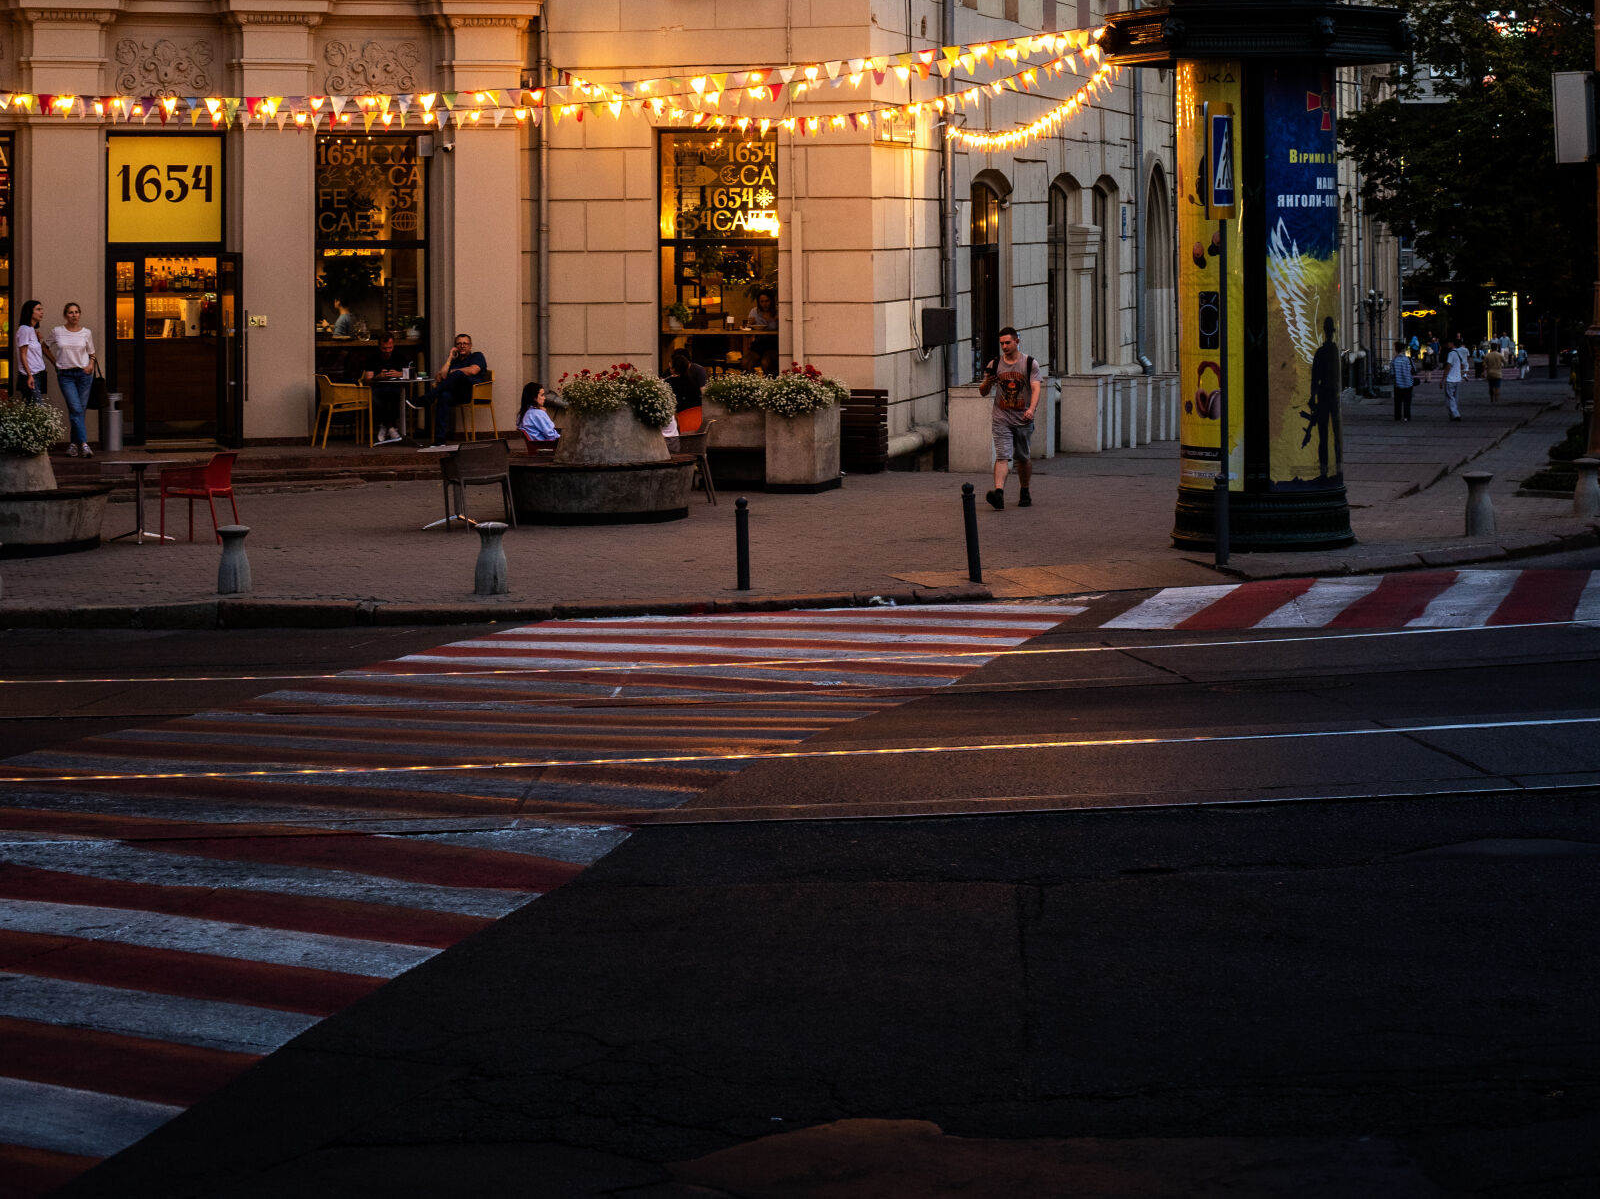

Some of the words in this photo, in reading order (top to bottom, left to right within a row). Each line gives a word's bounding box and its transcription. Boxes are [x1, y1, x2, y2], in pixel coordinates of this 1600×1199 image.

[317, 144, 368, 166] 1654
[727, 141, 776, 163] 1654
[116, 164, 213, 203] 1654
[388, 165, 422, 186] CA
[740, 164, 776, 186] CA
[318, 188, 348, 208] FE
[704, 187, 754, 209] 1654
